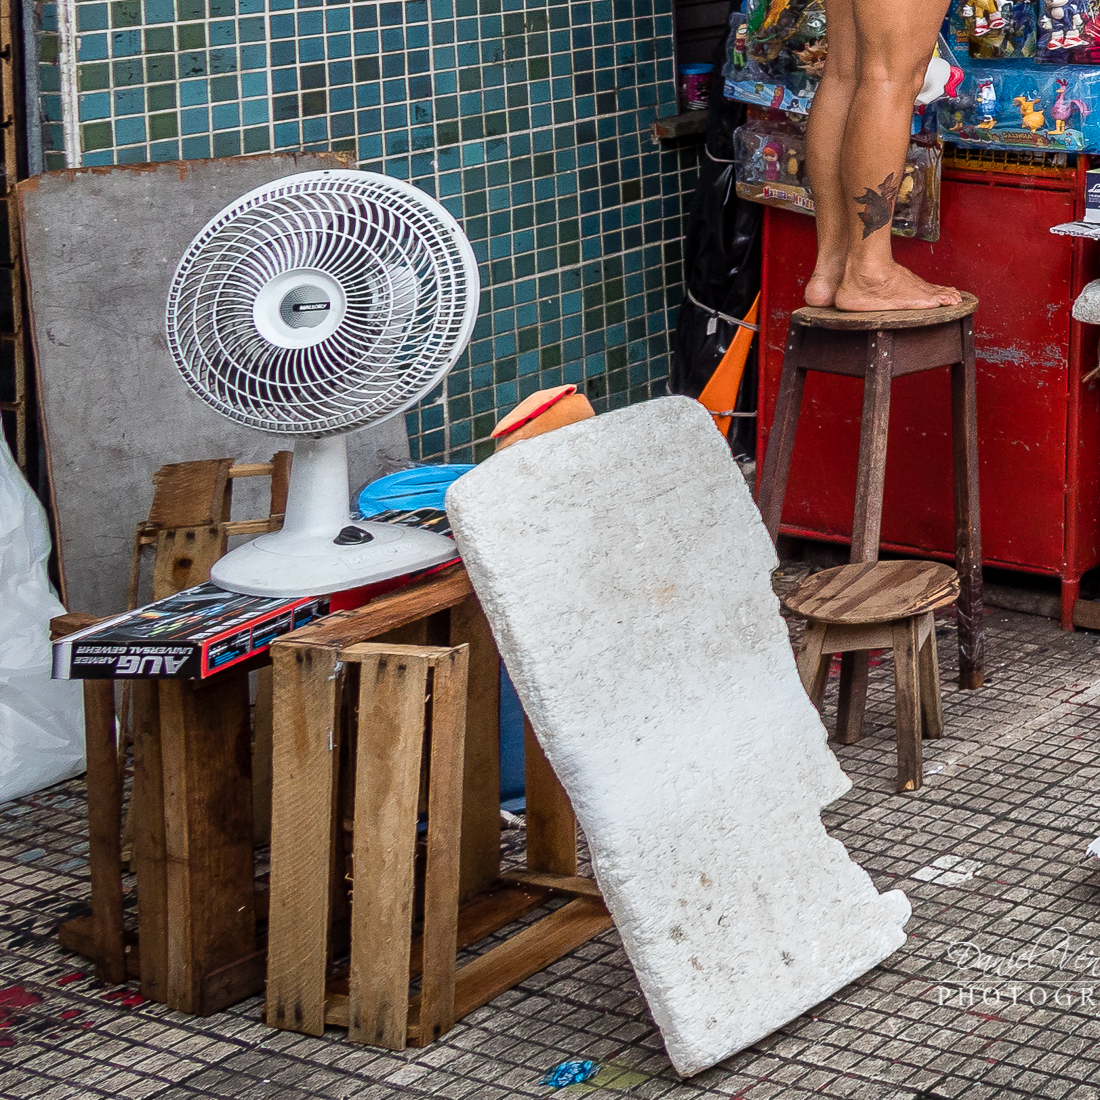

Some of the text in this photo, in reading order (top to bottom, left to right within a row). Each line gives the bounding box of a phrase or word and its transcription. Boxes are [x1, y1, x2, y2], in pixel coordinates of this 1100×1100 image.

[298, 303, 328, 311] MALLORY
[76, 645, 194, 656] UNIVERSAL GEWEHR
[73, 655, 190, 675] AUG ARMEE
